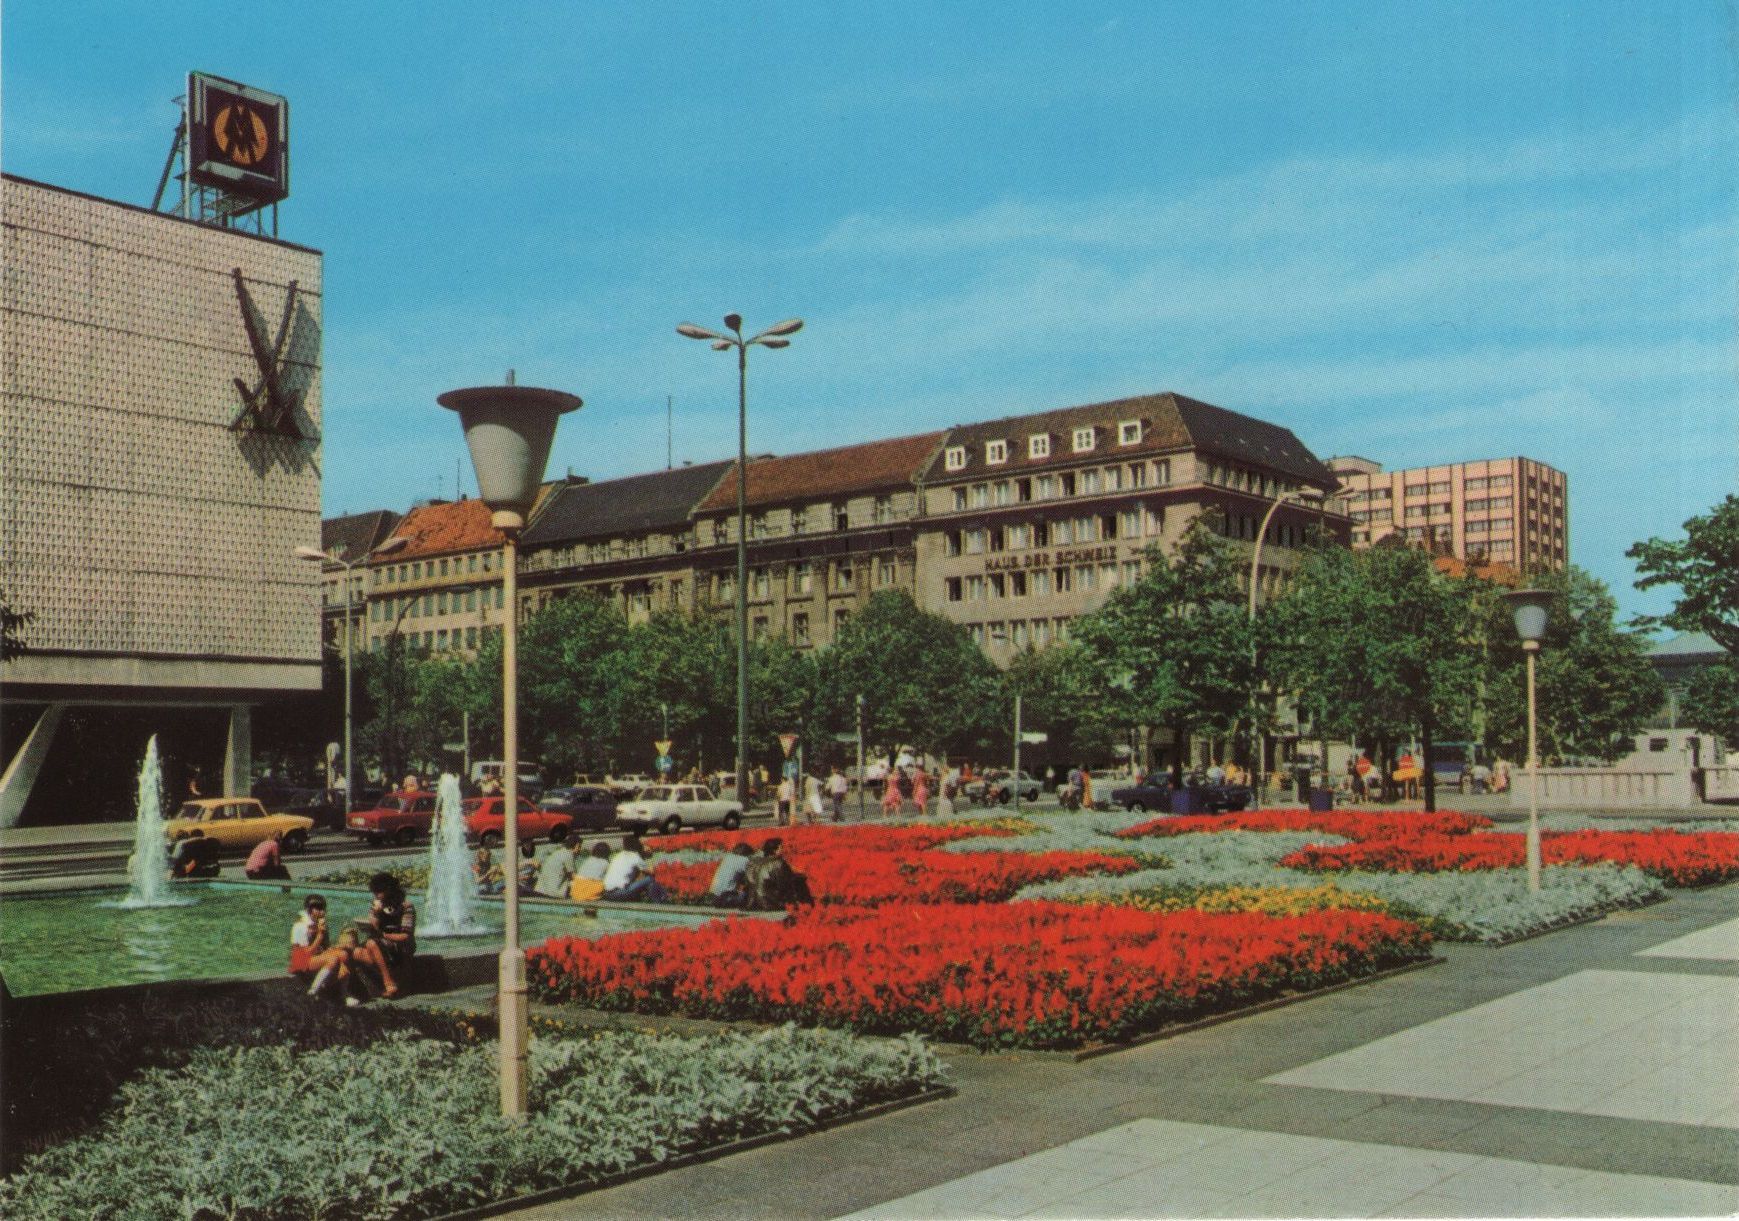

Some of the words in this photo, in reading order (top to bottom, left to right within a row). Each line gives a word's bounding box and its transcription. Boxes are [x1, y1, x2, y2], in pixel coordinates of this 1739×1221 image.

[985, 556, 1020, 571] HAUS
[1024, 552, 1050, 568] DER
[1055, 545, 1117, 564] SCHWEIZ
